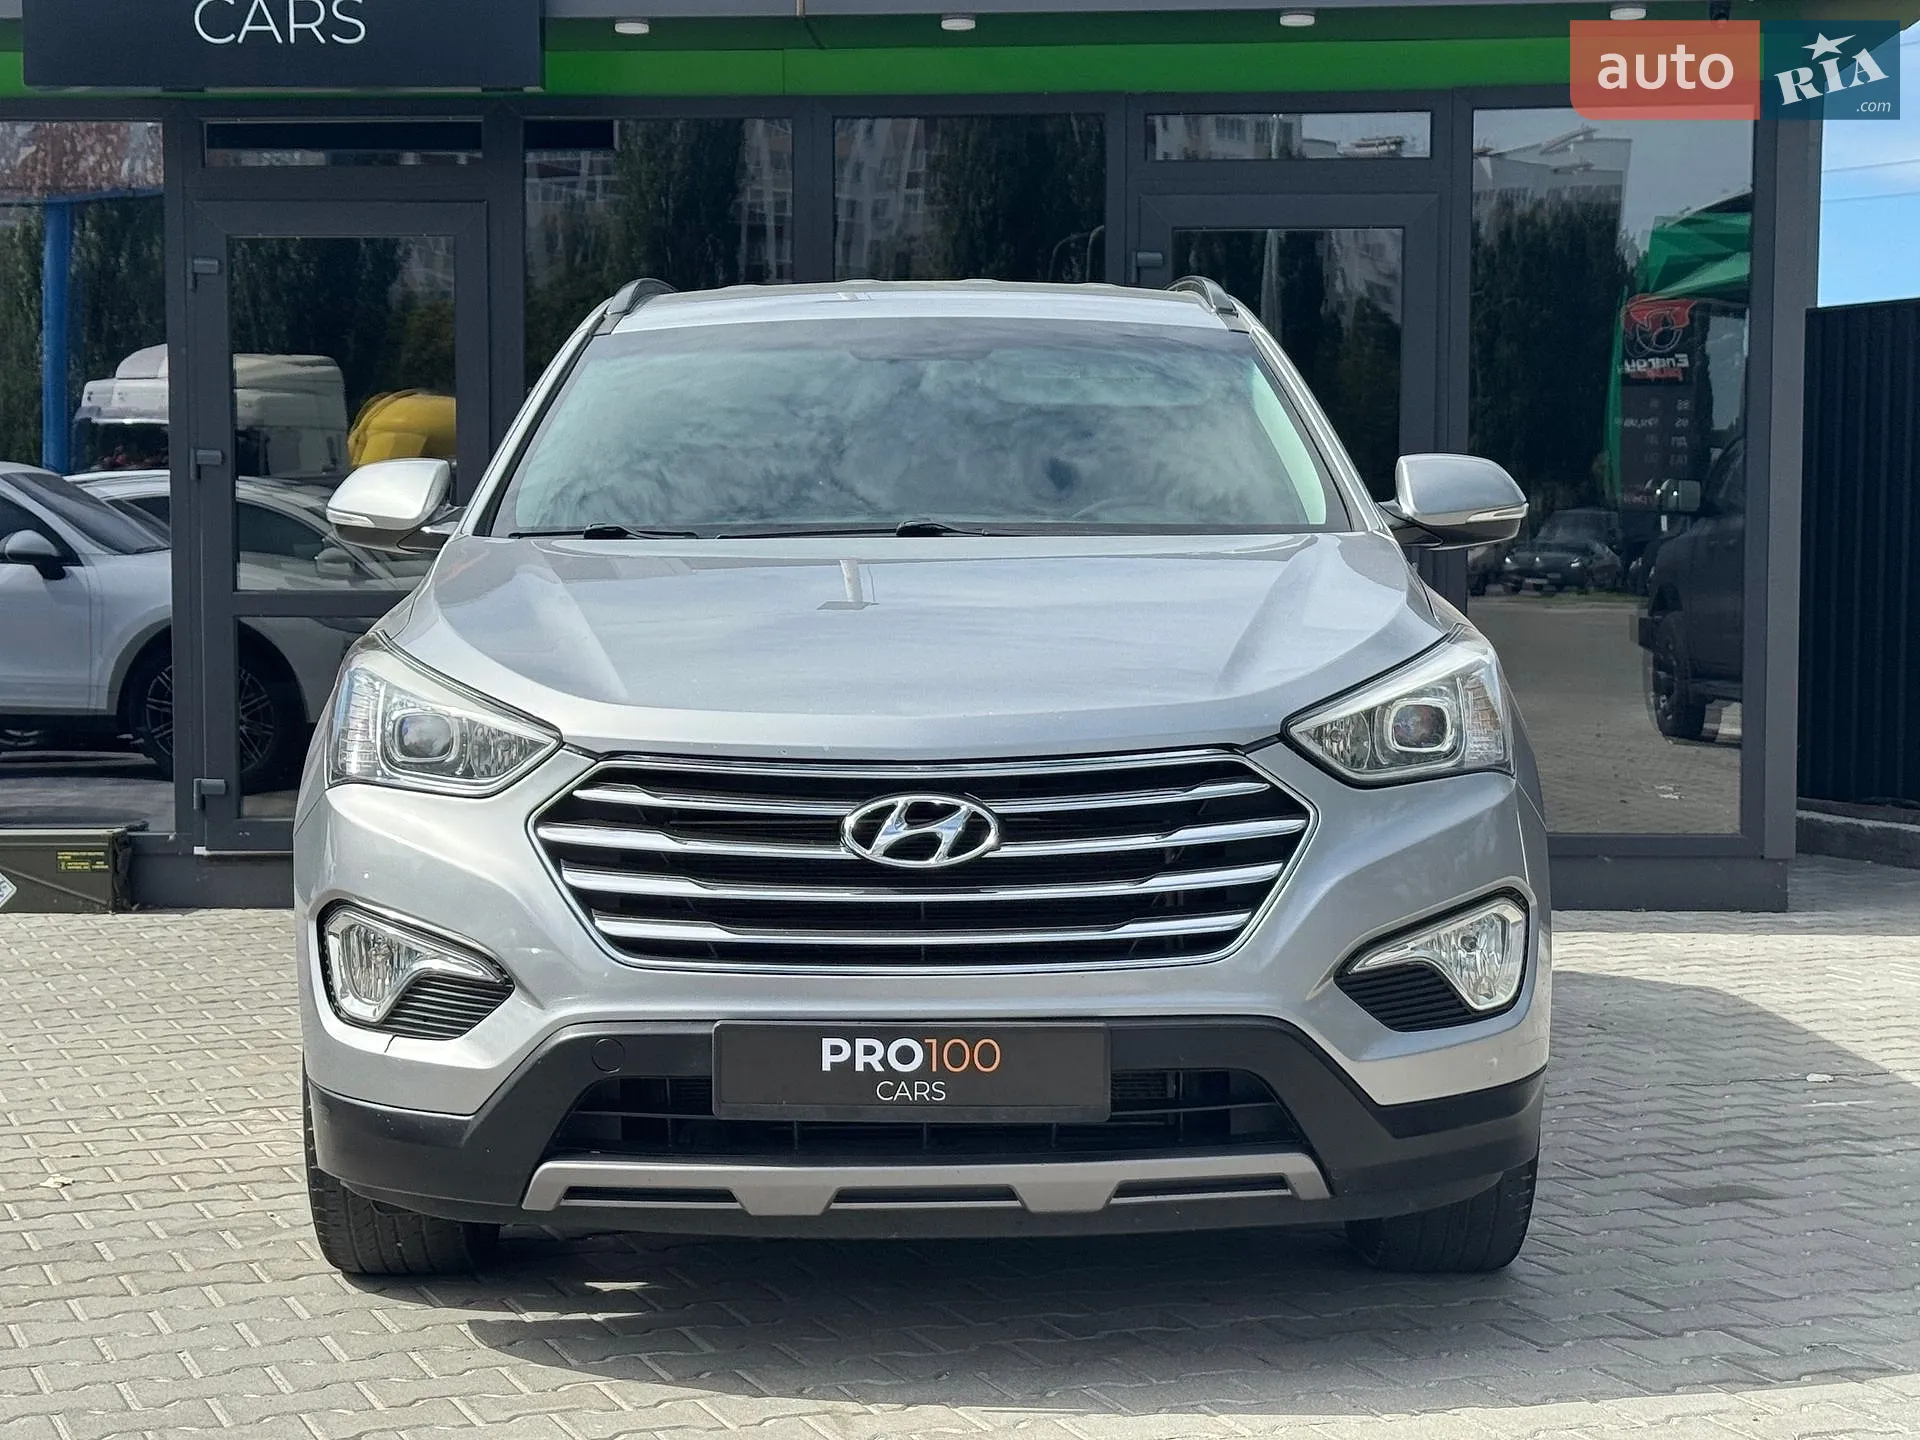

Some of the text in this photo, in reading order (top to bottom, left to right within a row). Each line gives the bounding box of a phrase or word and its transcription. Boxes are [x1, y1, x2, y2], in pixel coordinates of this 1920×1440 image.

[194, 0, 366, 44] CARS
[820, 1037, 1001, 1073] PRO100
[876, 1080, 946, 1102] CARS
